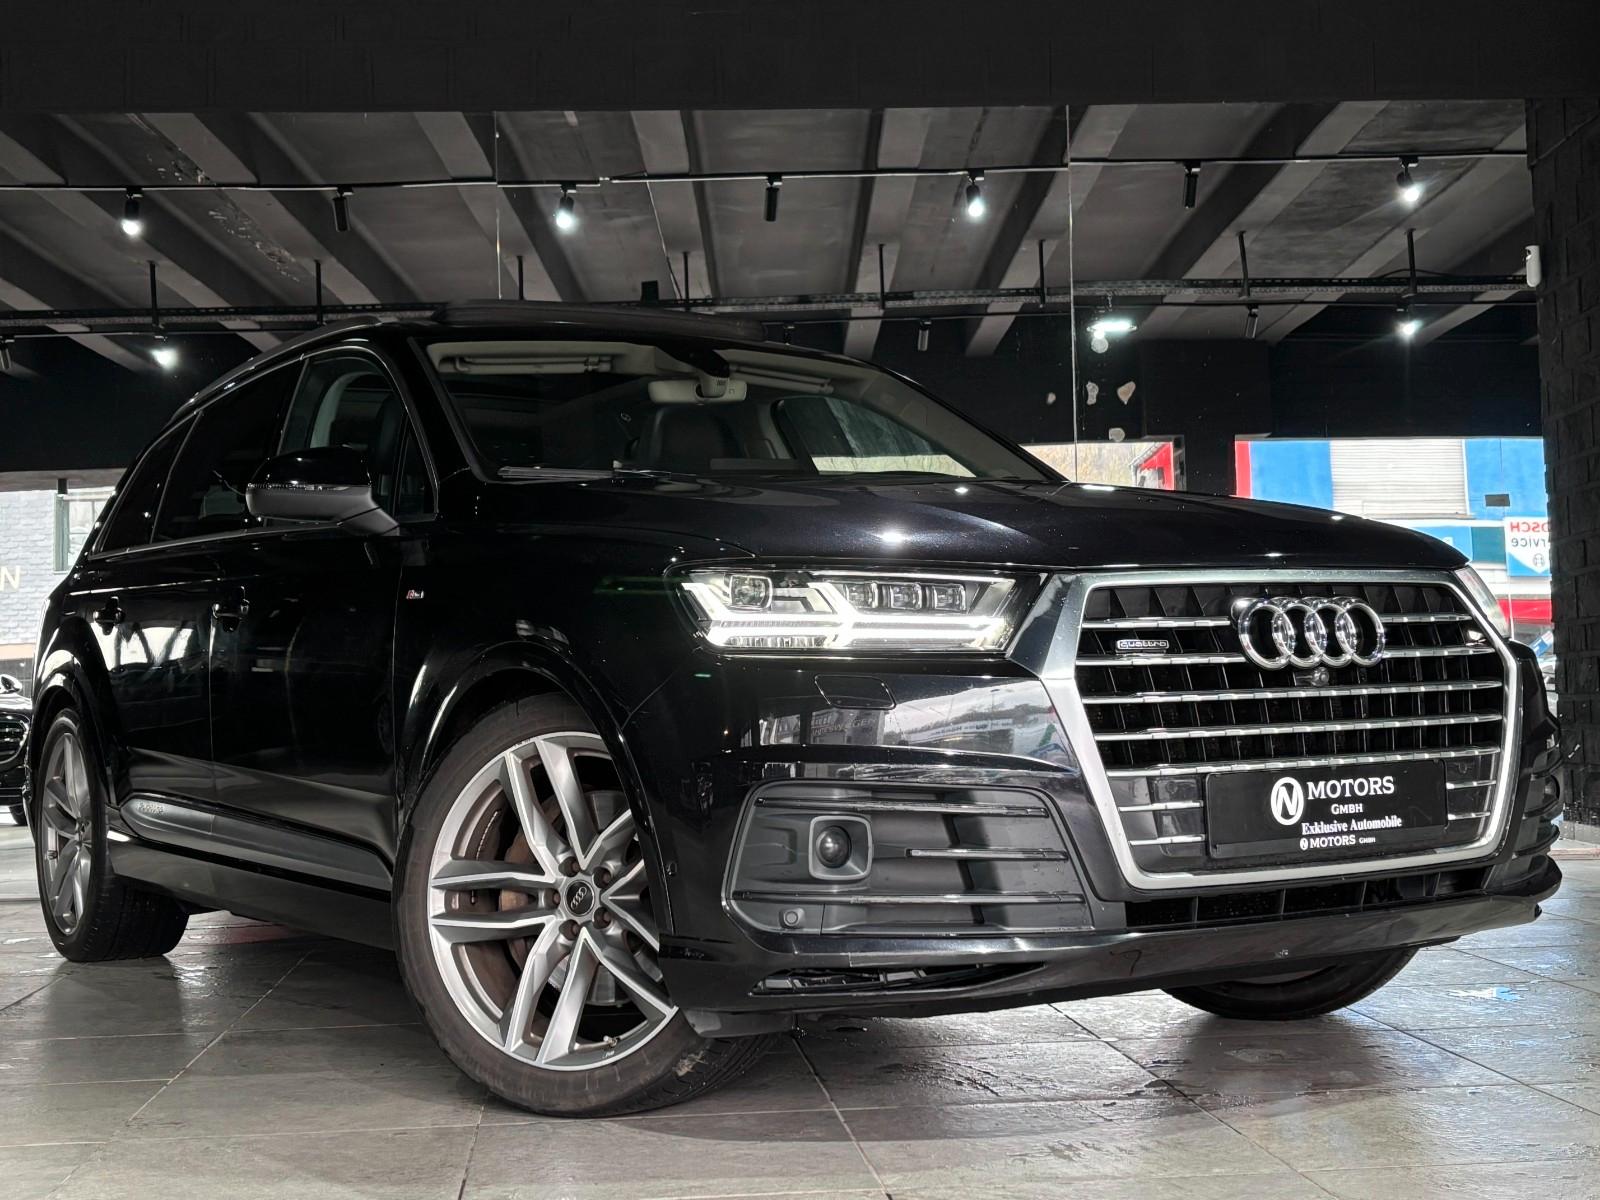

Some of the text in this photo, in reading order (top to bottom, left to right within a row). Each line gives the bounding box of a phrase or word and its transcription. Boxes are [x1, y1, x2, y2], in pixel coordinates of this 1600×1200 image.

[1120, 641, 1167, 649] quattro
[1306, 775, 1395, 800] MOTORS
[1331, 803, 1363, 815] GMBH
[1301, 815, 1403, 836] Exklusive Automobile
[1309, 834, 1356, 849] MOTORS
